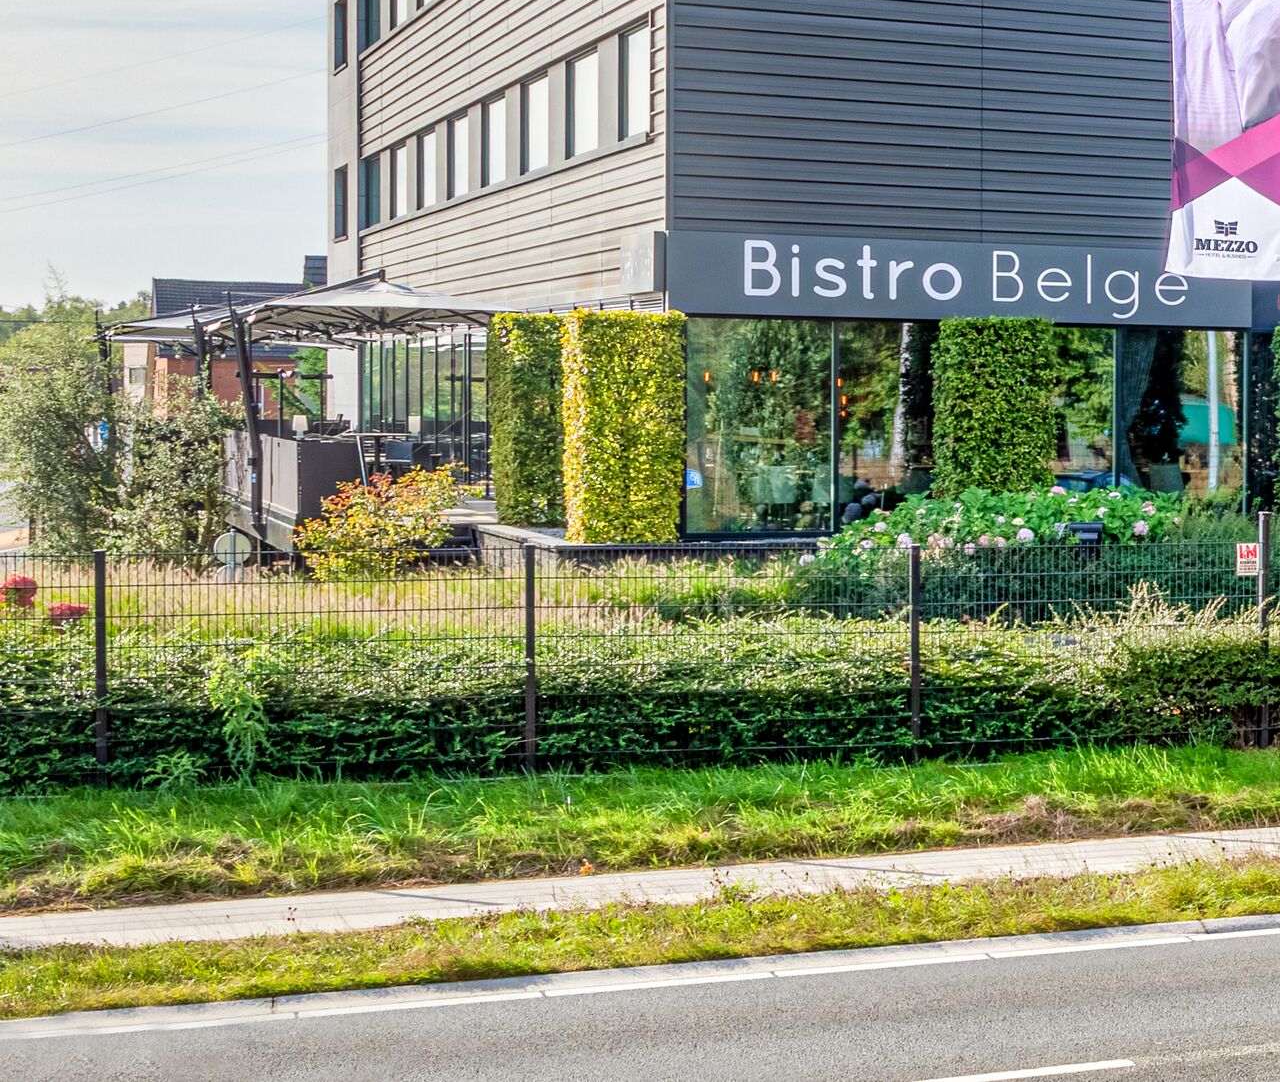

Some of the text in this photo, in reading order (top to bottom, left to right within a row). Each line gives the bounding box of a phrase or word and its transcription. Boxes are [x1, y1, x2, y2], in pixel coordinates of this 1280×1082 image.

[1194, 238, 1259, 253] MEZZO
[743, 239, 1189, 320] Bistro Belge
